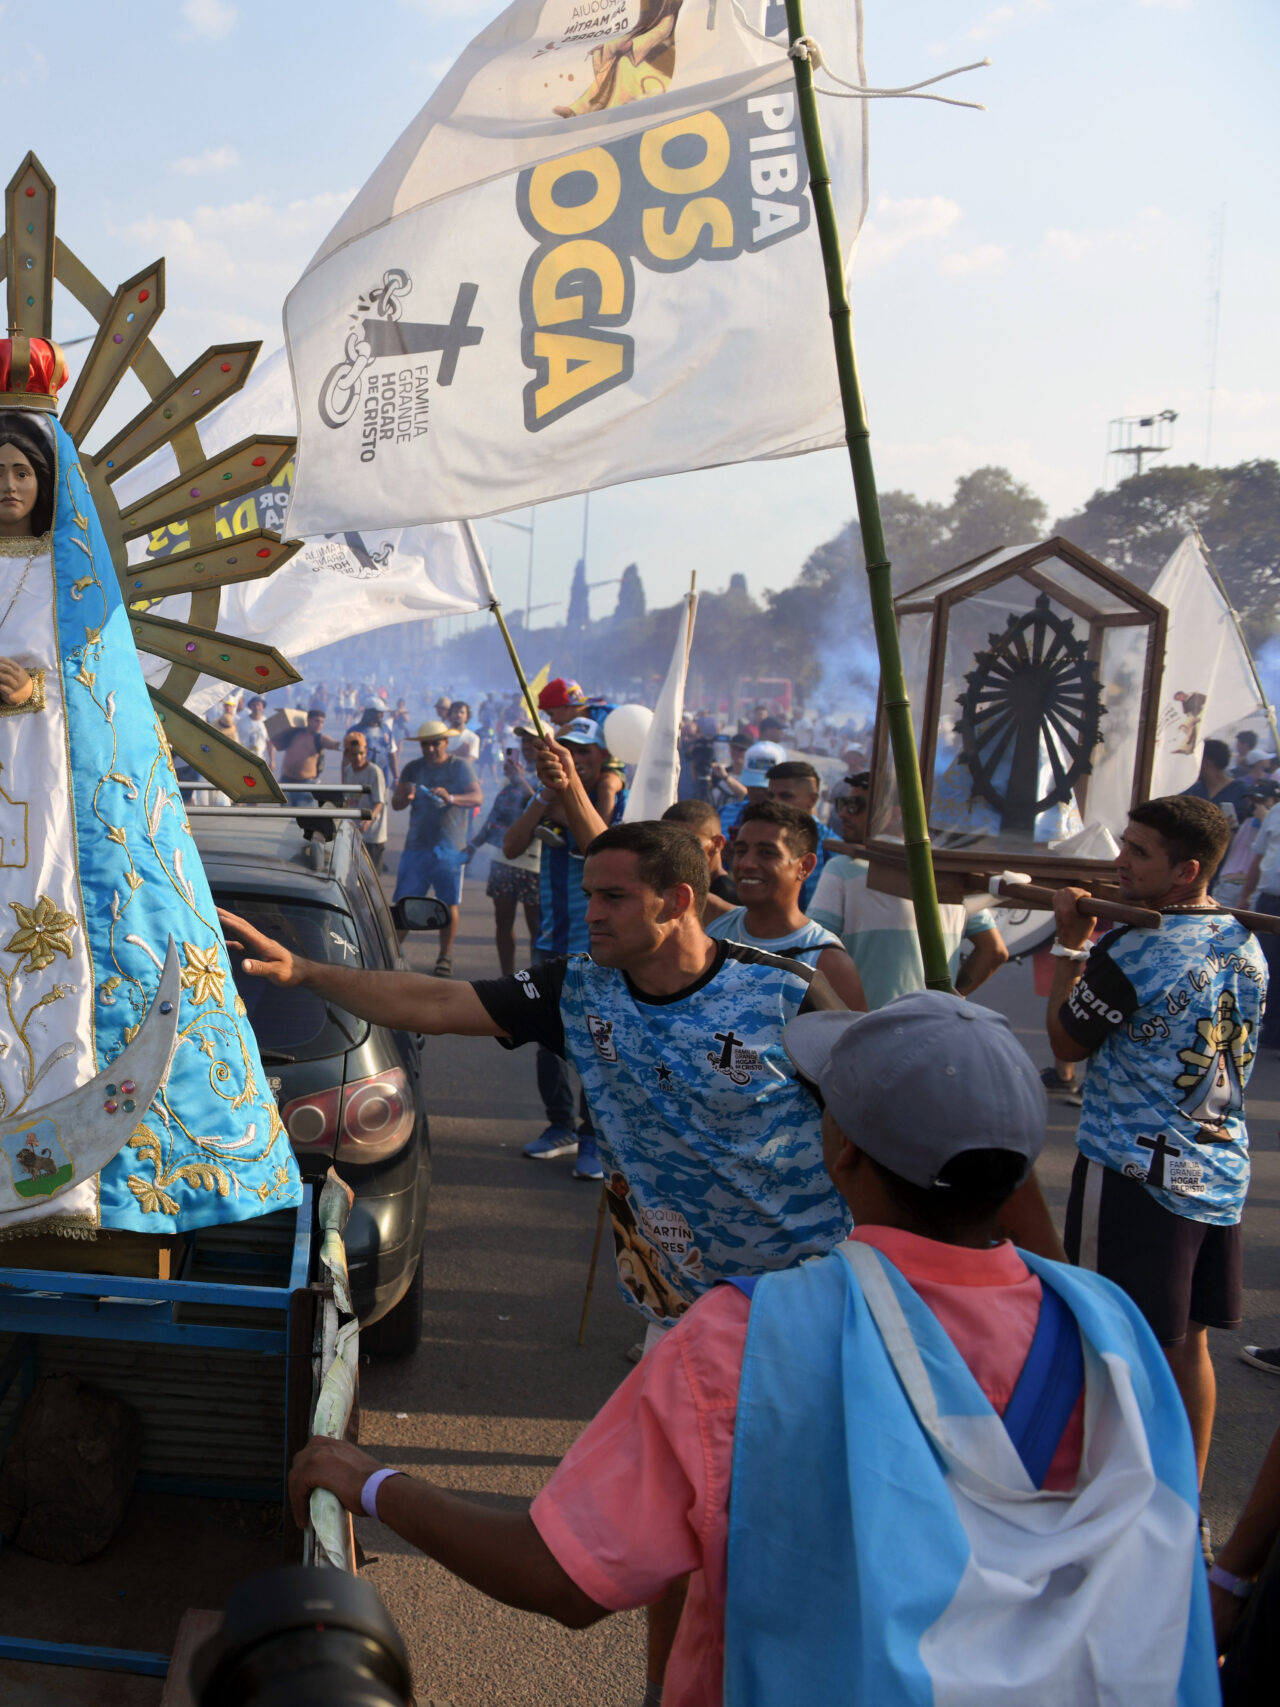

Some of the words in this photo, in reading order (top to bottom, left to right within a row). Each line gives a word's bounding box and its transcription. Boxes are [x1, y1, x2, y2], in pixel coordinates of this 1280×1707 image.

[747, 91, 800, 243] PIBA
[368, 375, 379, 395] DE
[379, 372, 396, 440] HOGAR
[396, 368, 413, 444] GRANDE
[413, 365, 429, 438] FAMILIA
[360, 396, 379, 463] CRISTO
[1127, 1015, 1170, 1046] Soy
[1166, 989, 1191, 1016] de
[1188, 970, 1211, 993] la
[1206, 943, 1265, 989] Virgen
[1170, 1169, 1202, 1177] GRANDE
